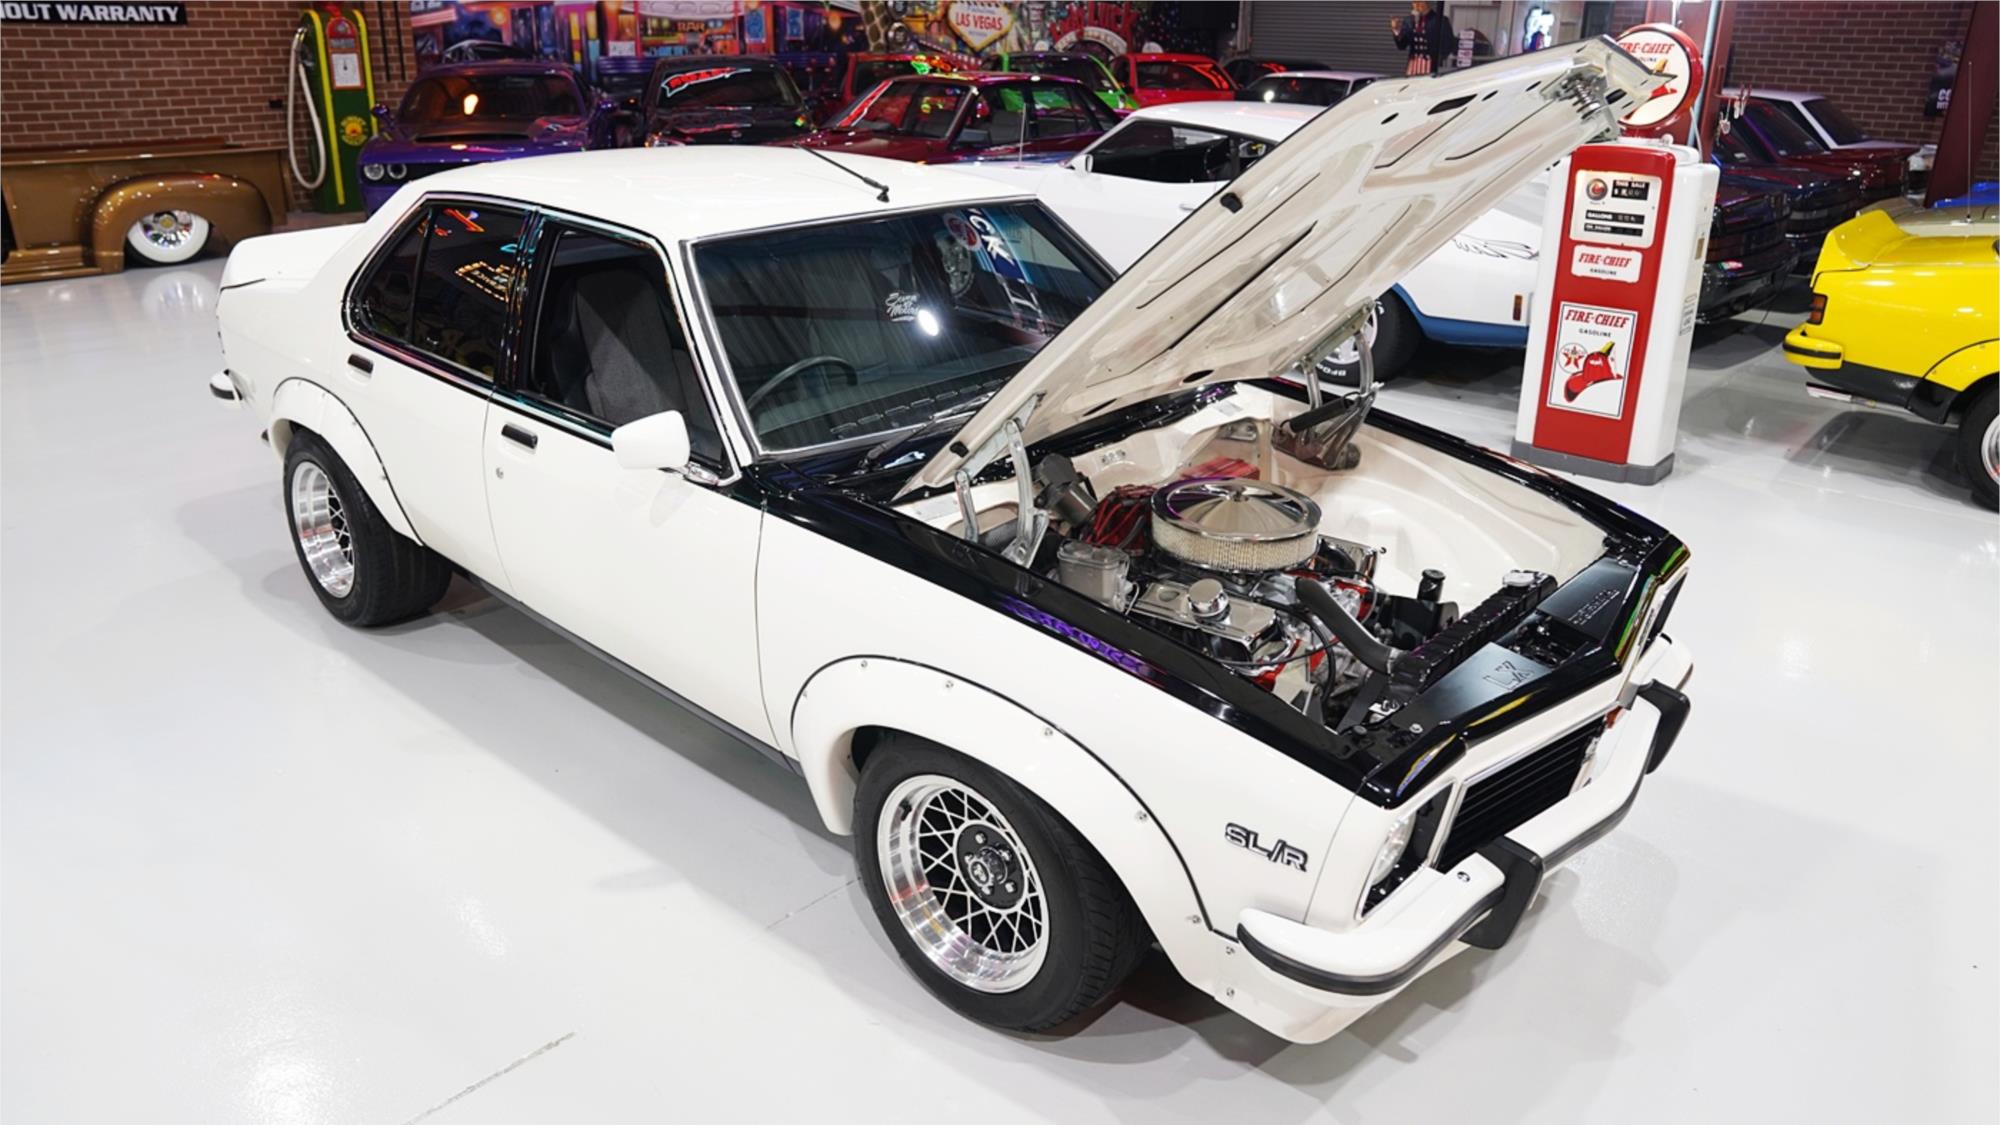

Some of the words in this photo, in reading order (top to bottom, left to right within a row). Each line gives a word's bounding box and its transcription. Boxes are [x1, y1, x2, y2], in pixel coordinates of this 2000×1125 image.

[56, 4, 178, 22] WARRANTY
[955, 11, 970, 28] LAS
[972, 14, 1003, 31] VEGAS
[1578, 252, 1632, 268] FIRE-CHIEF
[1565, 309, 1630, 328] FIRE-CHIEF
[1578, 328, 1611, 337] GASOLINE
[1224, 822, 1308, 872] SL/R
